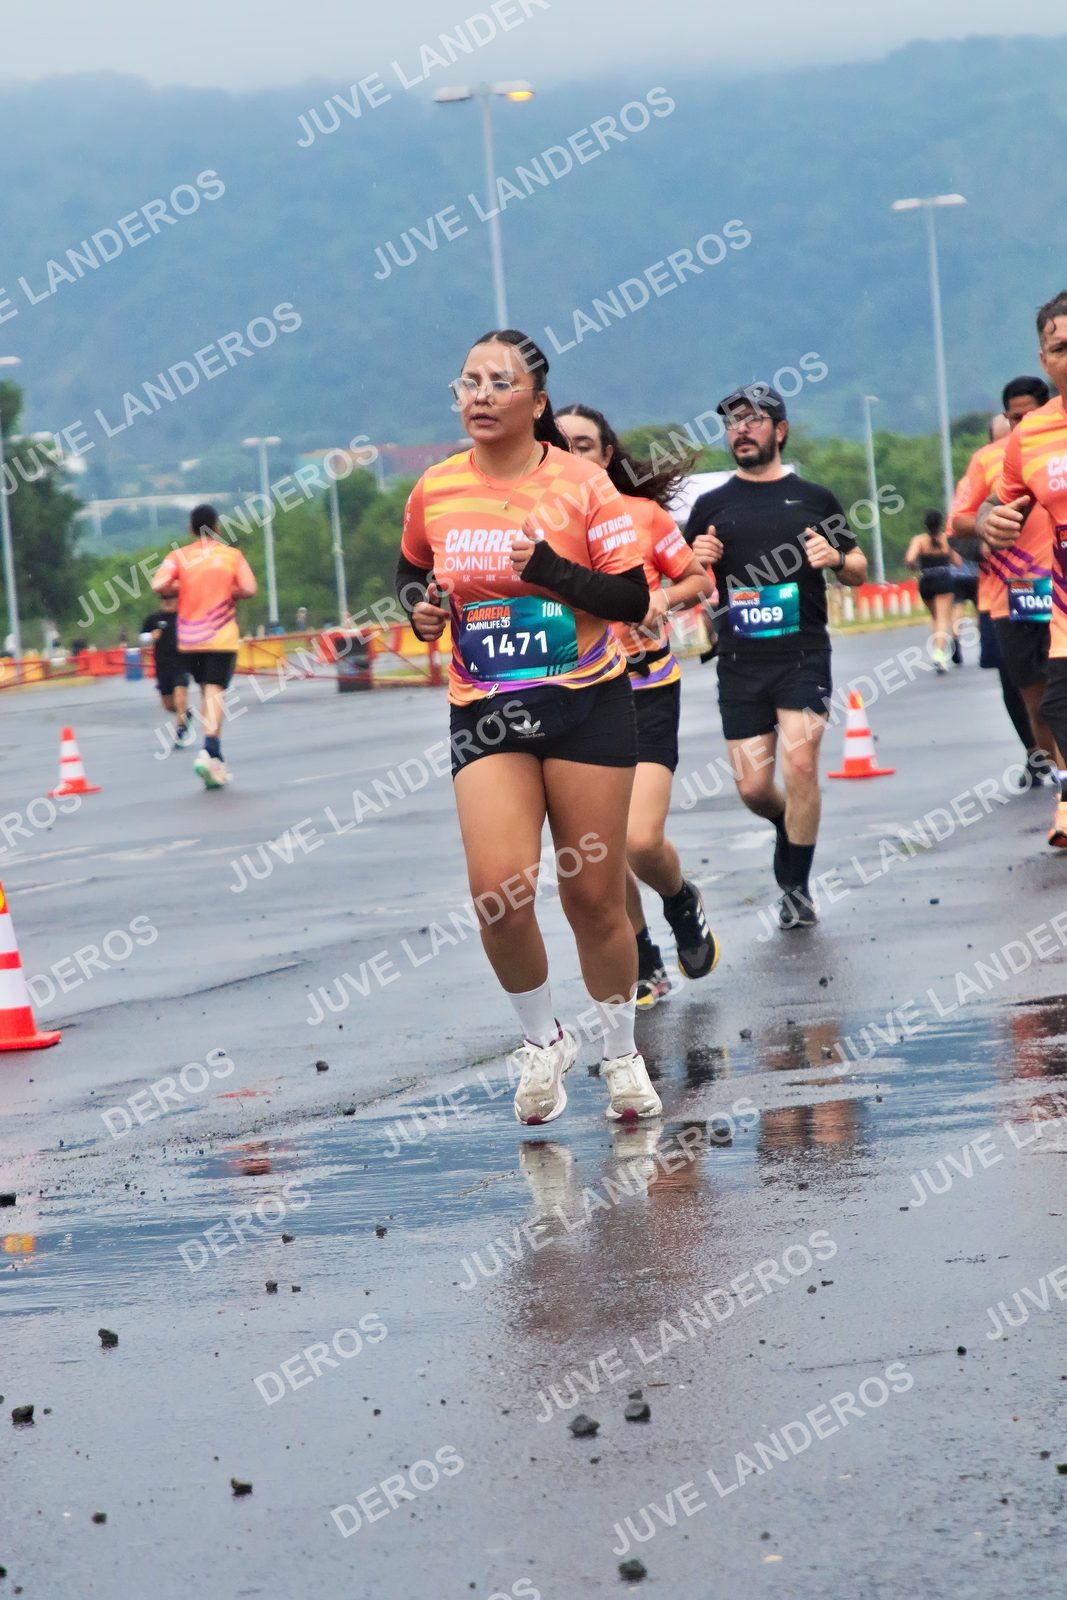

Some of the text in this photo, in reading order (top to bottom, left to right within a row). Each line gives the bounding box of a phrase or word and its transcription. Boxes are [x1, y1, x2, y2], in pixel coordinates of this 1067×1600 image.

[444, 556, 514, 571] OMNILIF
[466, 605, 510, 622] CARRERA
[541, 602, 563, 617] 10K
[740, 606, 783, 623] 1069
[466, 620, 500, 631] OMNILIFE
[482, 630, 547, 658] 1471
